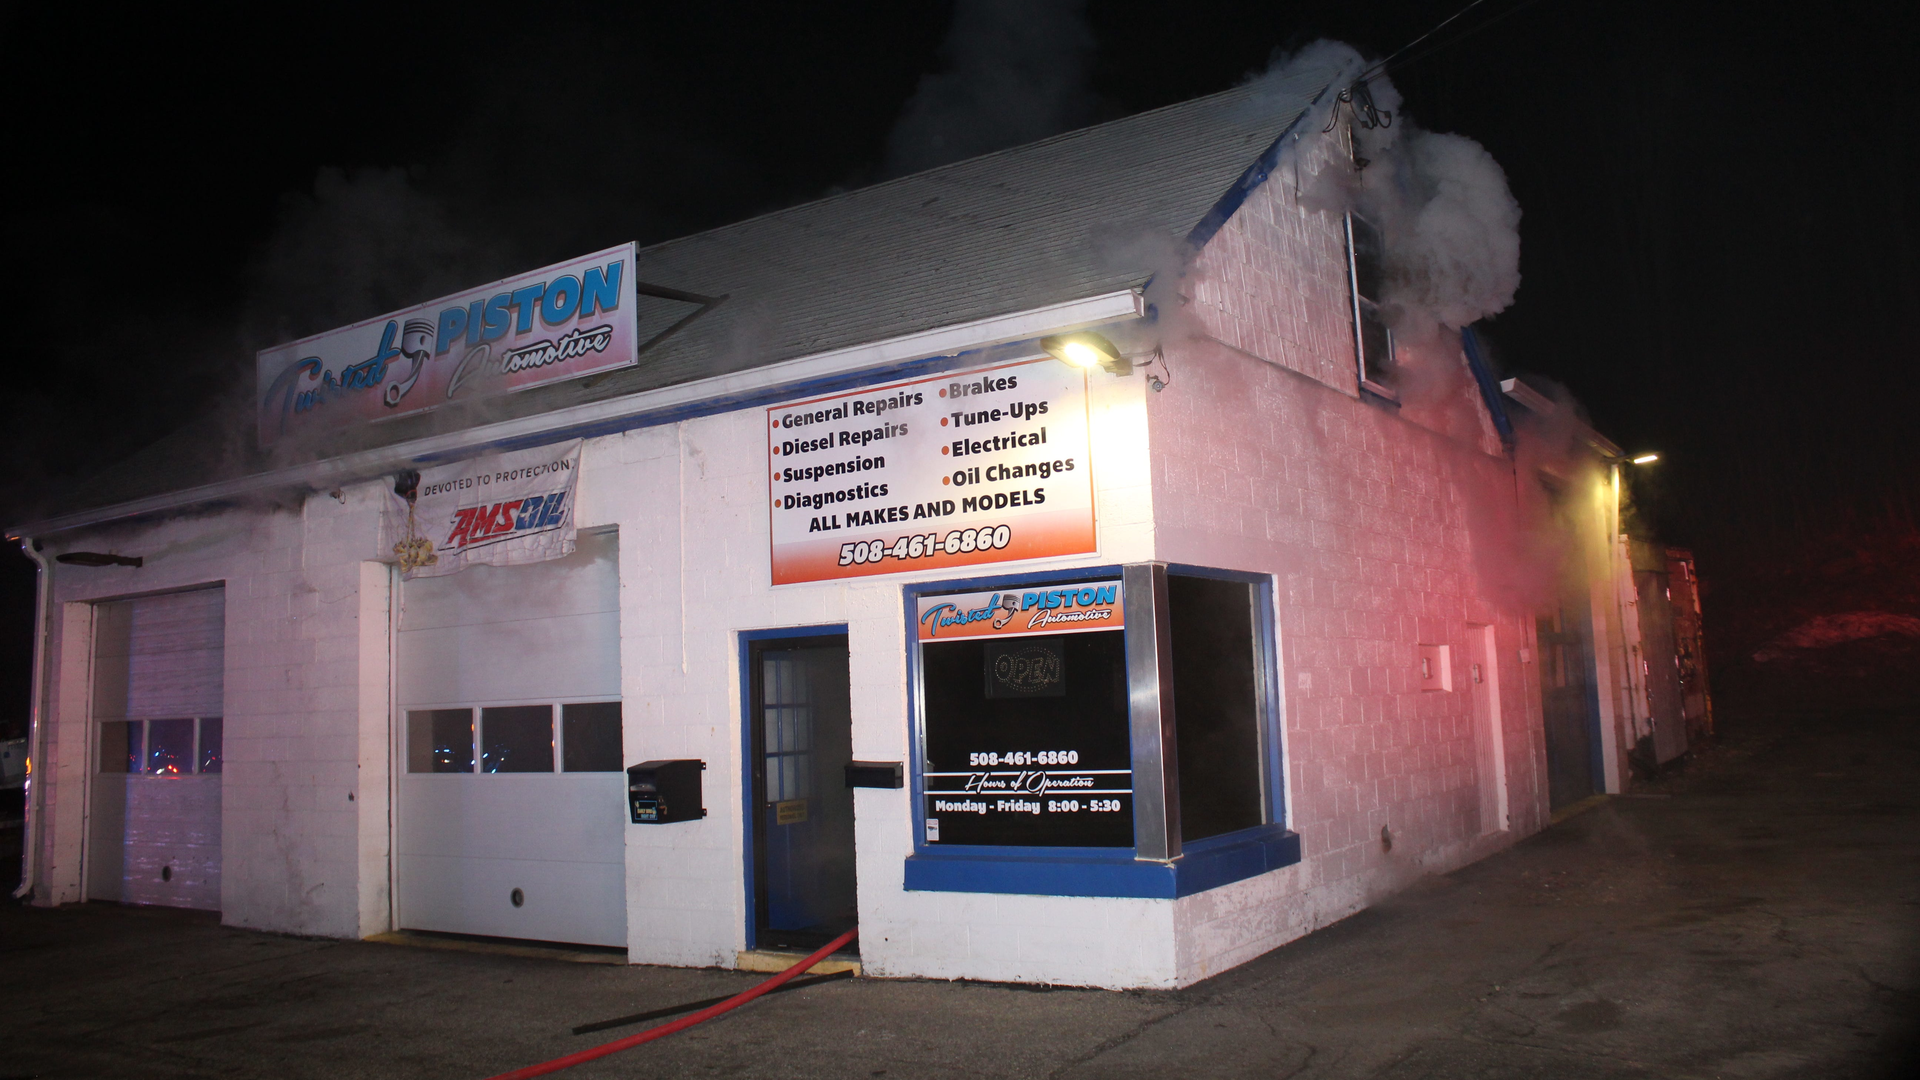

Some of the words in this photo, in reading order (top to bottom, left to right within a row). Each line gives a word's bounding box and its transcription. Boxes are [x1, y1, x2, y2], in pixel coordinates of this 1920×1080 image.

[435, 259, 624, 355] PISTON
[447, 324, 613, 398] Automotive
[949, 375, 1018, 400] Brakes
[782, 401, 849, 429] General
[853, 391, 923, 417] Repairs
[951, 399, 1049, 428] Tune-Ups
[782, 432, 835, 457] Diesel
[839, 421, 909, 447] Repairs
[952, 426, 1047, 457] Electrical
[783, 455, 886, 483] Suspension
[952, 466, 981, 487] Oil
[985, 457, 1075, 483] Changes
[424, 479, 473, 496] DEVOTED
[477, 474, 491, 486] TO
[783, 482, 889, 511] Diagnostics
[447, 491, 567, 548] AMSOIL
[809, 515, 841, 533] ALL
[846, 505, 909, 528] MAKES
[913, 500, 956, 520] AND
[962, 488, 1046, 513] MODELS
[838, 524, 1011, 567] 508-461-6860
[1021, 585, 1117, 611] PISTON
[921, 593, 1002, 636] Twisted
[1027, 609, 1112, 629] Automotive
[994, 654, 1060, 684] OPEN
[969, 750, 1079, 767] 508-461-6860
[965, 772, 1006, 794] Hours
[1010, 770, 1028, 791] of
[1026, 771, 1095, 797] Operation
[935, 800, 987, 815] Monday
[997, 799, 1041, 815] Friday
[1048, 800, 1079, 812] 8:00
[1090, 799, 1121, 812] 5:30
